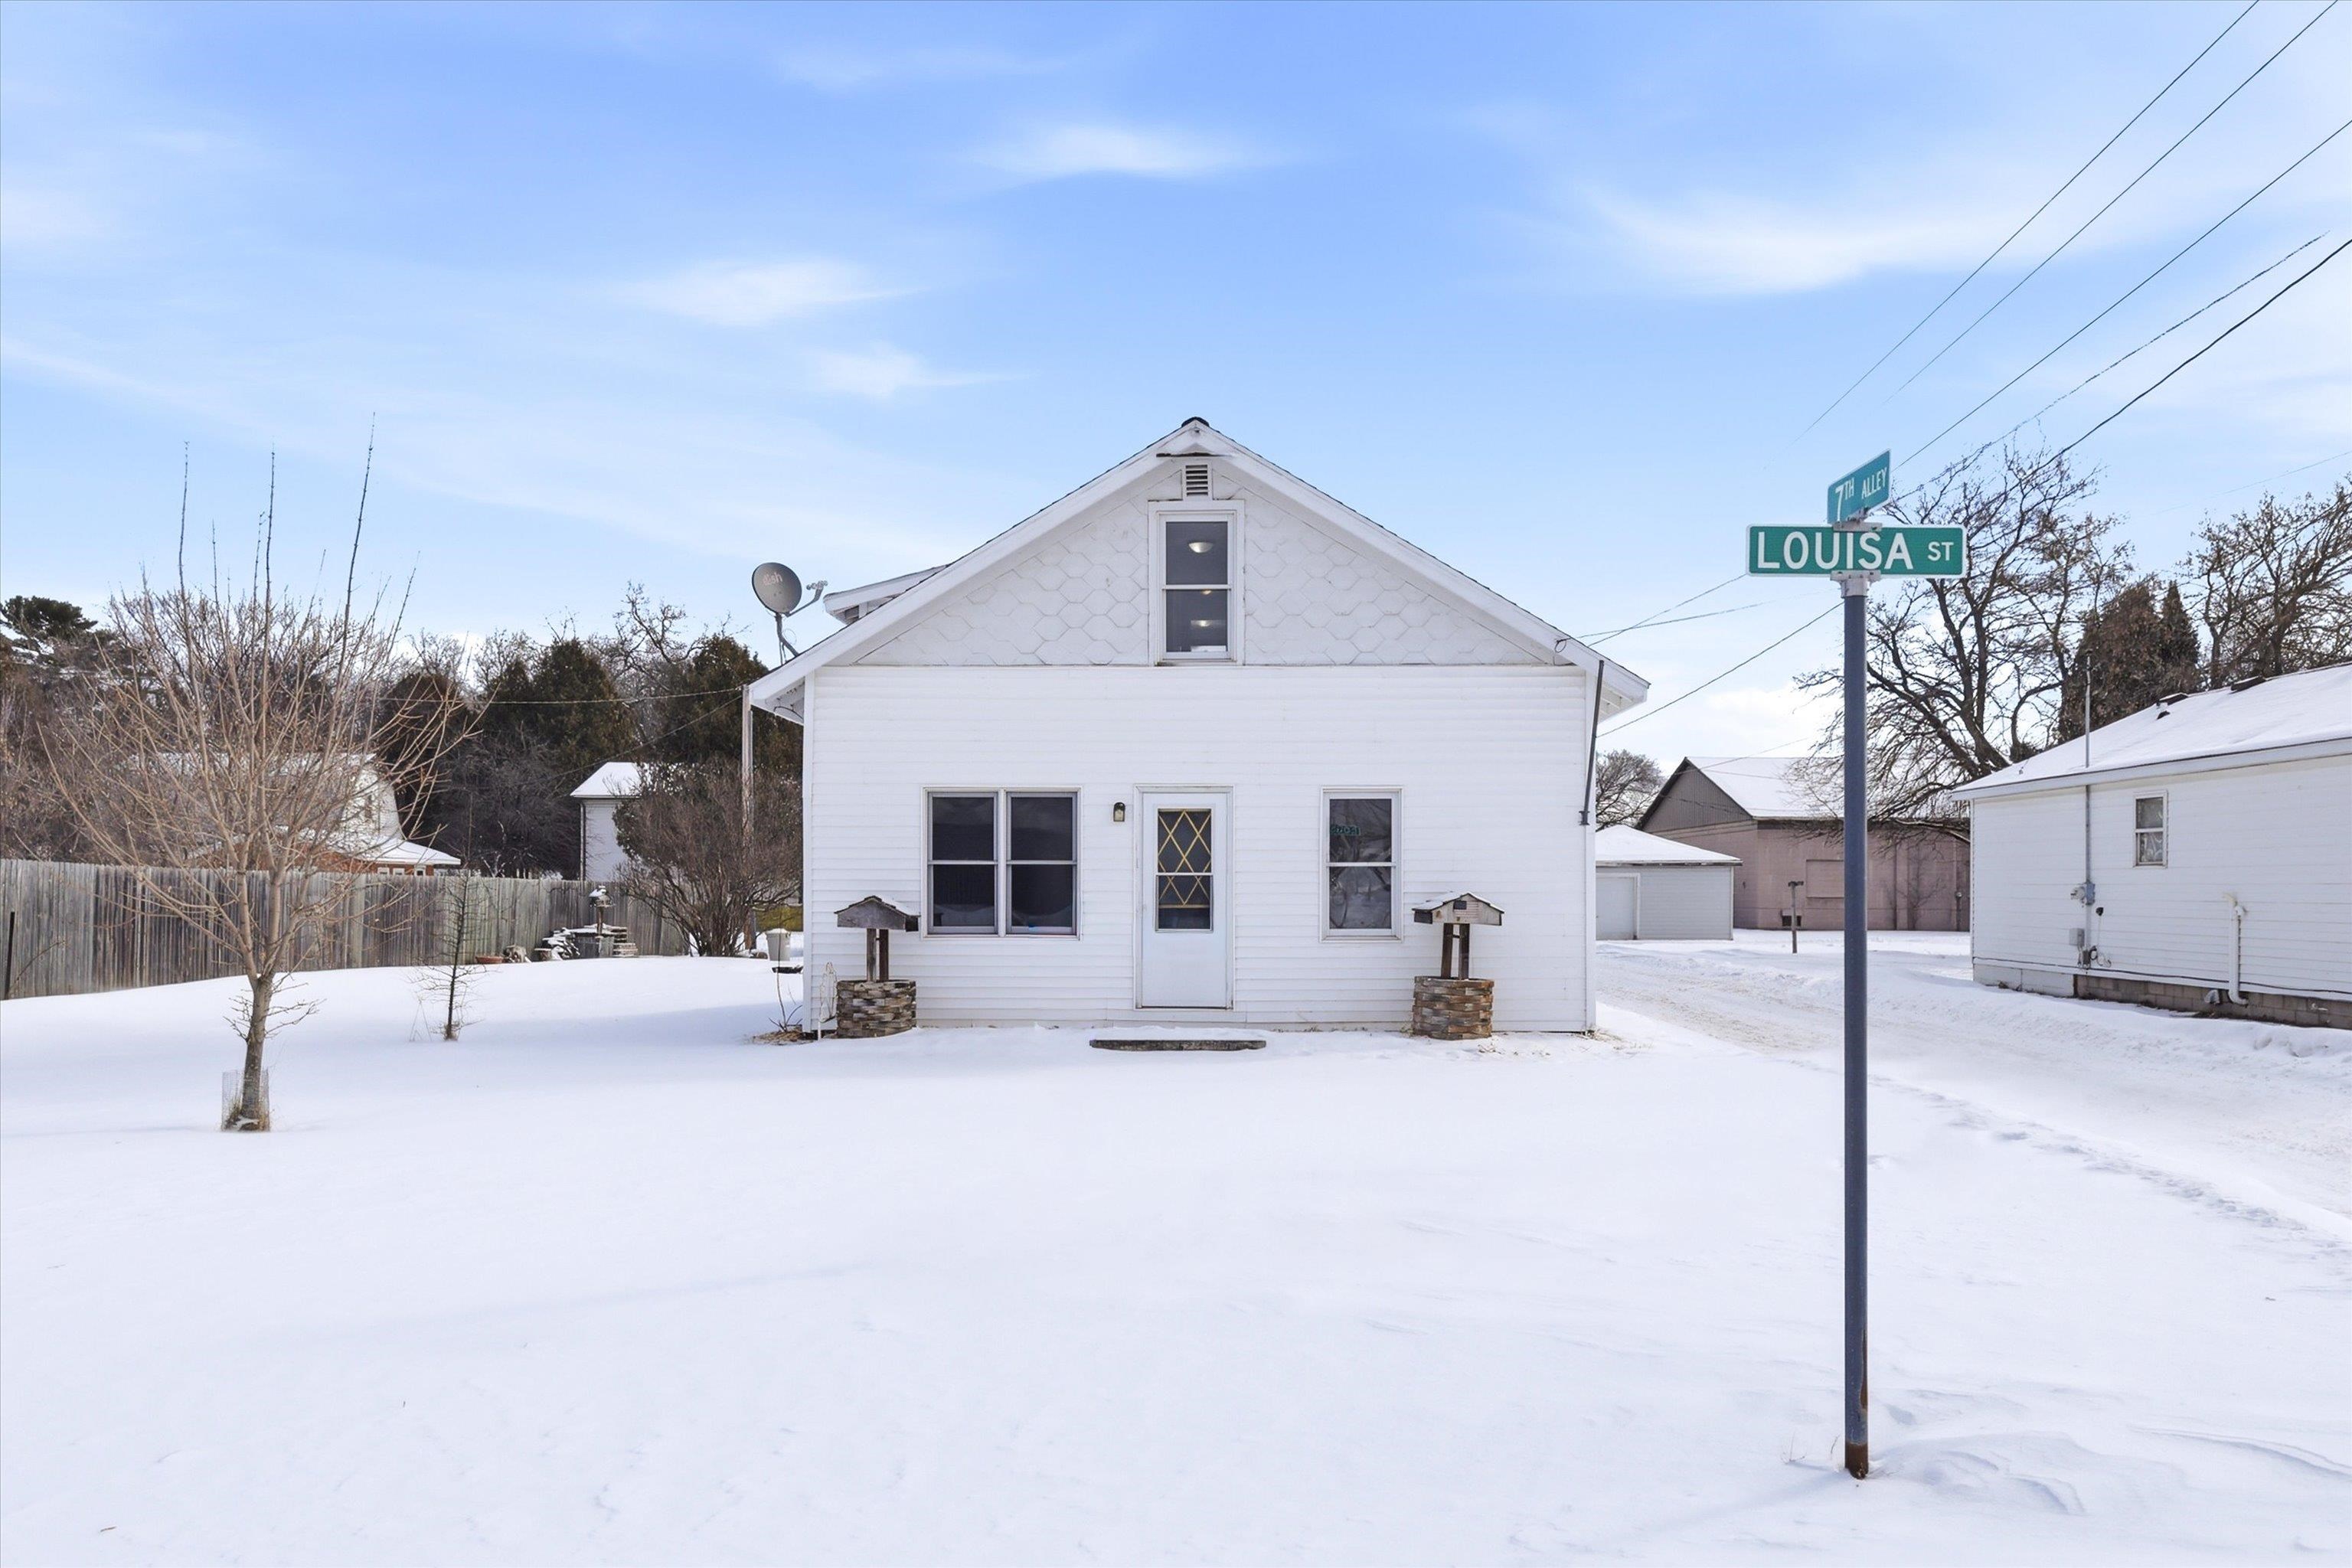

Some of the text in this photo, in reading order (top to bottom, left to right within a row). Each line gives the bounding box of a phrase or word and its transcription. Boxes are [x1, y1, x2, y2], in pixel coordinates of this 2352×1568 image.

[1834, 468, 1887, 521] 7TH ALLEY
[1757, 531, 1954, 570] LOUISA ST
[763, 572, 783, 585] dish
